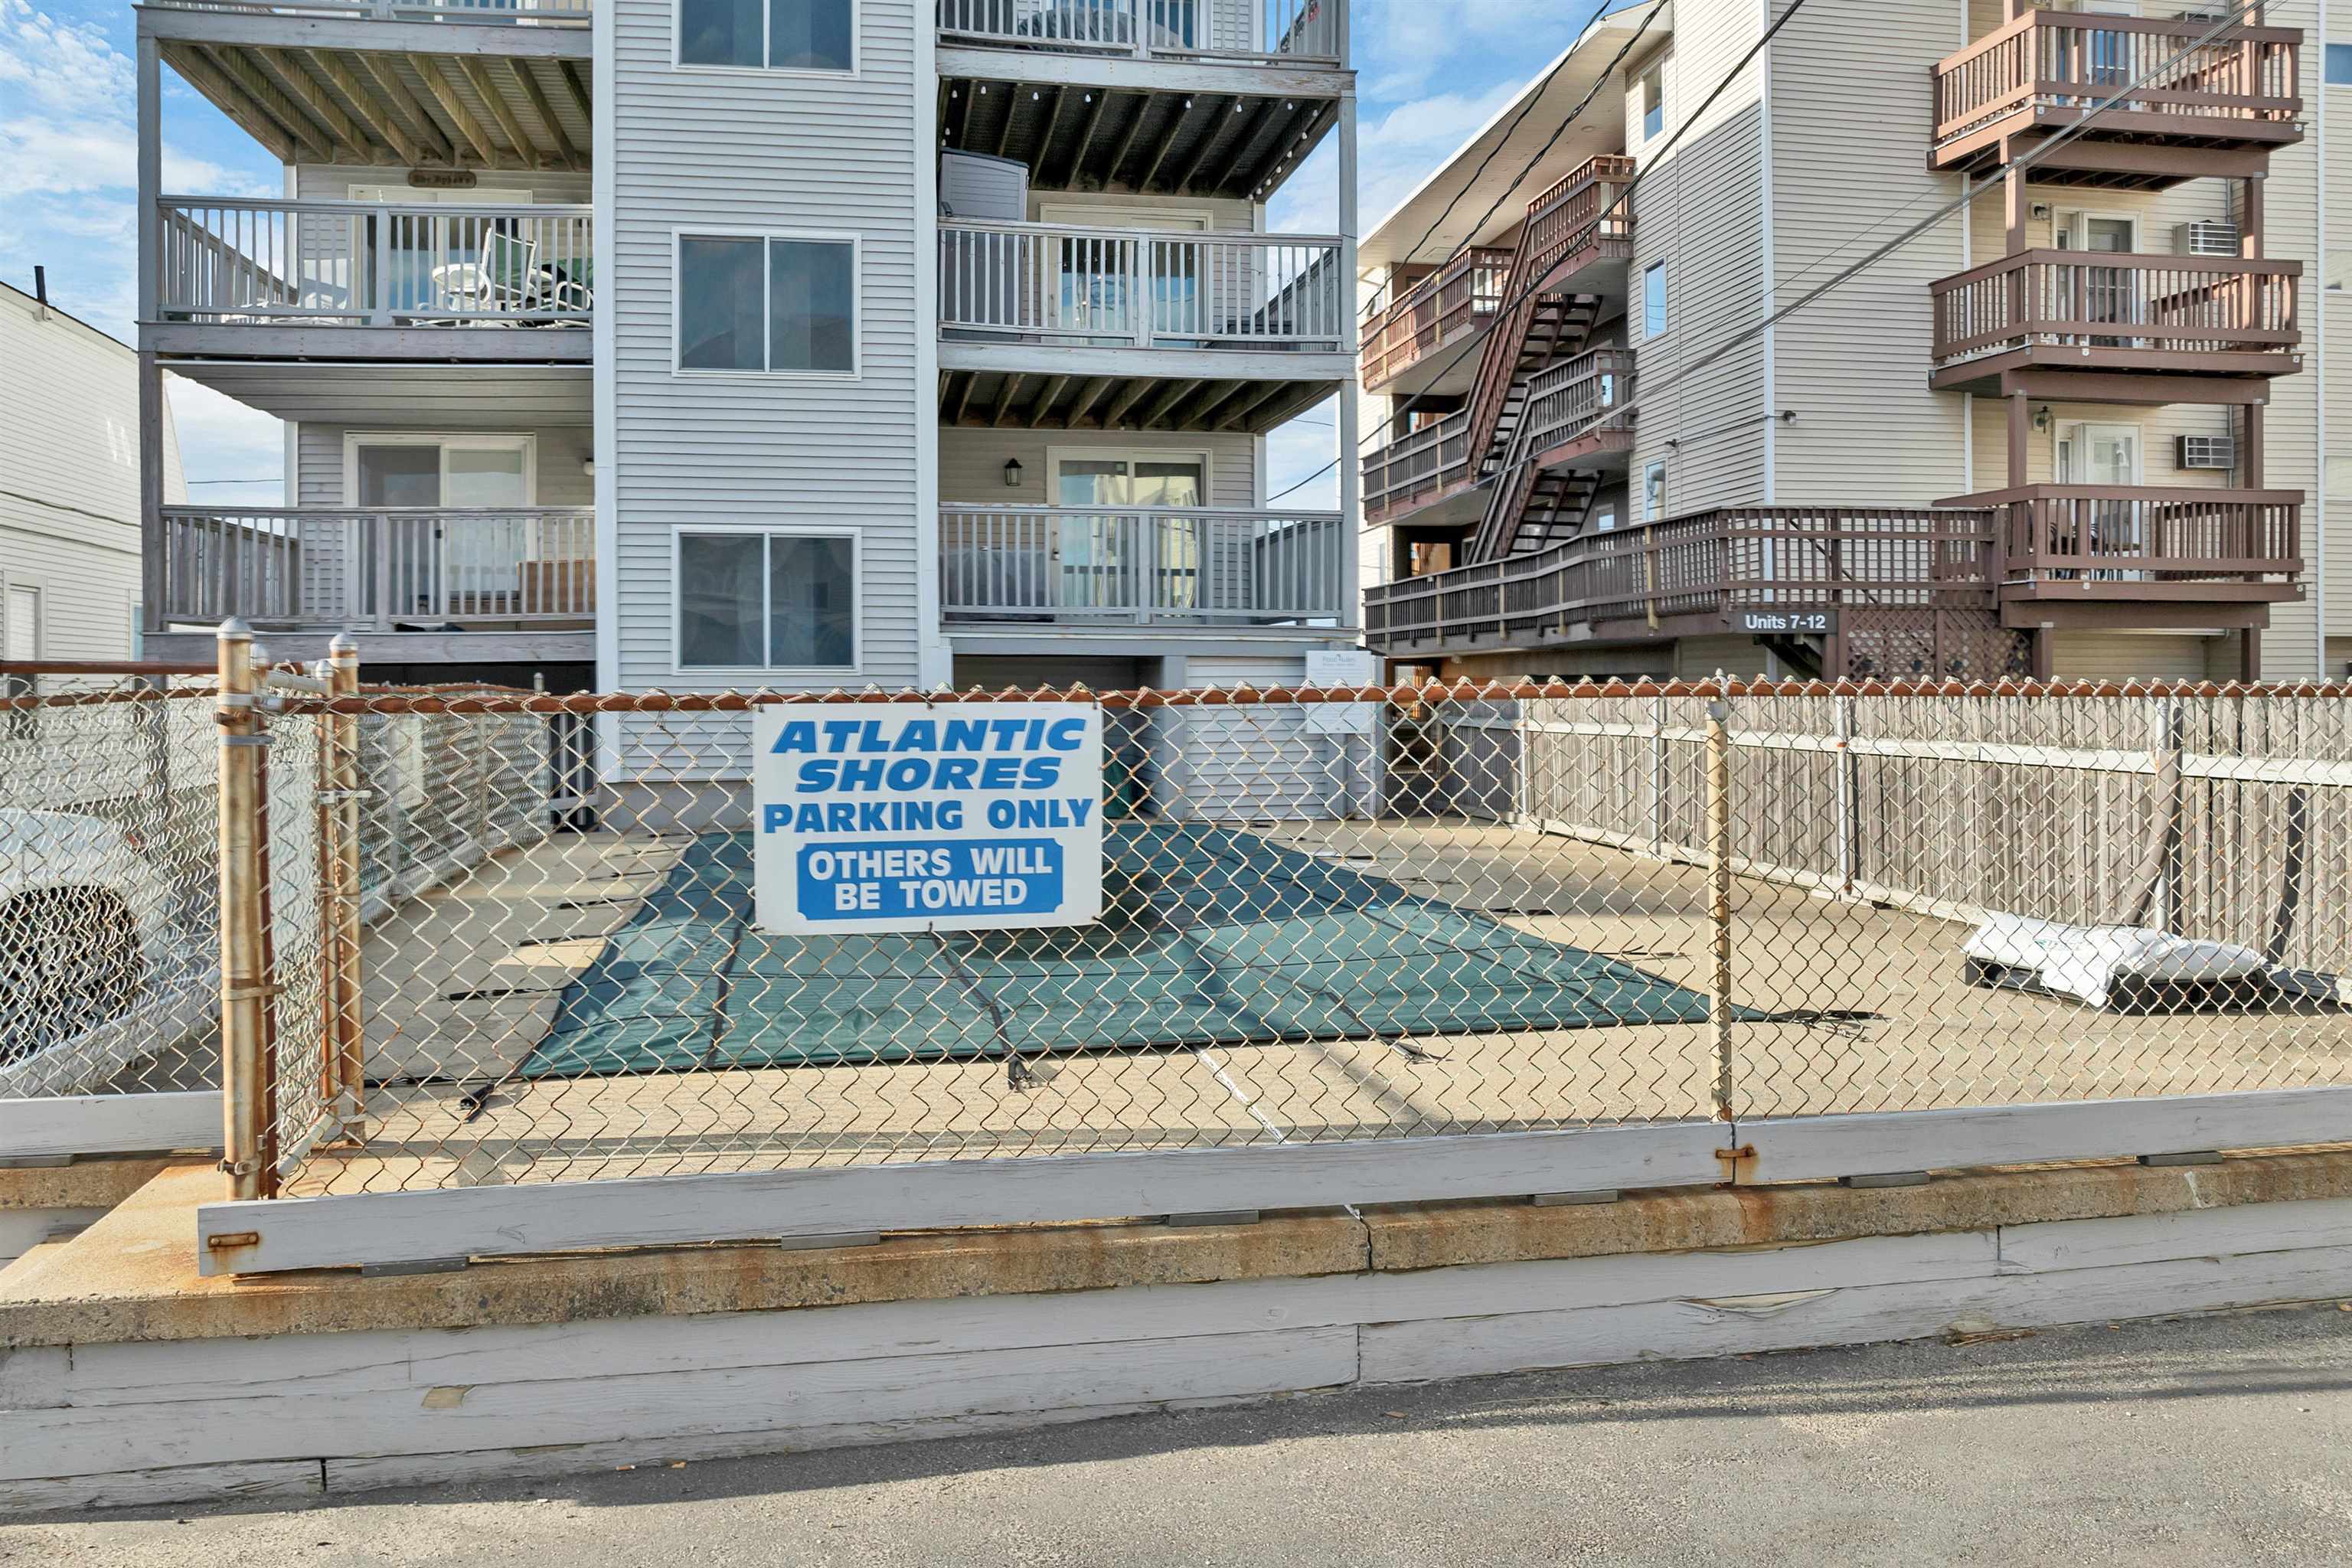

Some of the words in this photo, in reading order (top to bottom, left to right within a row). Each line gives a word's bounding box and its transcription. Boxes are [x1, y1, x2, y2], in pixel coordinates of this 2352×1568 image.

[1745, 614, 1787, 629] Units
[1789, 614, 1826, 629] 7-12
[770, 718, 1086, 754] ATLANTIC
[795, 756, 1062, 793] SHORES
[763, 800, 963, 834] PARKING
[987, 799, 1093, 830] ONLY
[808, 848, 951, 880] OTHERS
[970, 847, 1053, 875] WILL
[835, 882, 880, 910] BE
[899, 879, 1027, 909] TOWED
